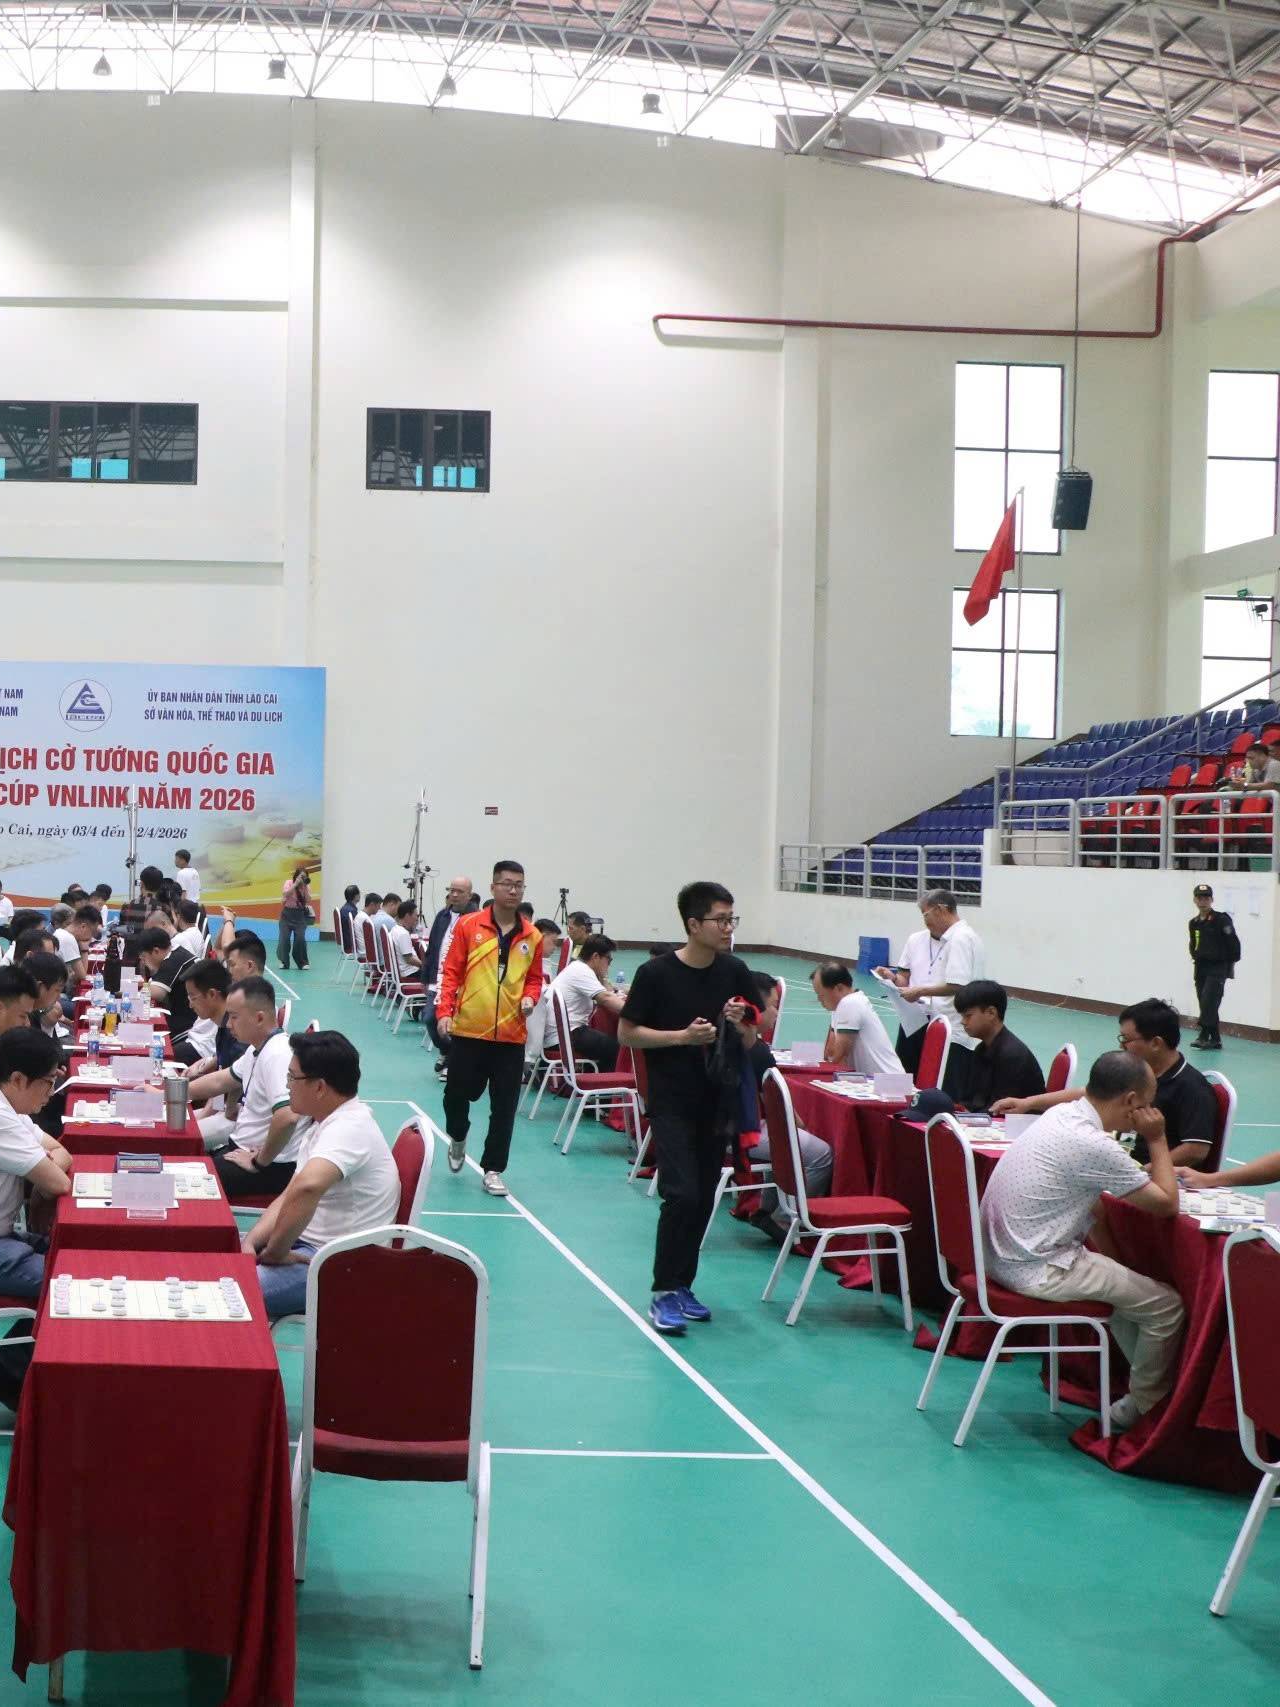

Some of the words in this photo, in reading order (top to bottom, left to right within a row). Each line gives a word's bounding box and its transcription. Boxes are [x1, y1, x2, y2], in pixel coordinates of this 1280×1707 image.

[4, 688, 23, 699] NAM
[147, 688, 158, 702] ỦY
[160, 691, 177, 703] BAN
[180, 690, 203, 703] NHÂN
[205, 691, 222, 704] DÂN
[225, 689, 243, 704] TỈNH
[246, 693, 261, 704] LAO
[263, 693, 277, 705] CAI
[144, 705, 156, 720] SỞ
[158, 708, 174, 720] VĂN
[198, 706, 214, 721] THỂ
[215, 710, 236, 722] THAO
[238, 709, 249, 722] VÀ
[251, 711, 262, 722] DU
[264, 711, 283, 724] LỊCH
[45, 742, 77, 771] CỜ
[83, 745, 158, 773] TƯỚNG
[166, 743, 229, 776] QUỐC
[236, 751, 275, 775] GIA
[46, 784, 130, 809] VNLINK
[138, 782, 192, 810] NĂM
[199, 788, 255, 811] 2026
[8, 823, 33, 836] Cai,
[37, 824, 69, 839] ngày
[72, 825, 97, 837] 03/4
[101, 824, 125, 838] đến
[134, 826, 188, 839] 2/4/2026
